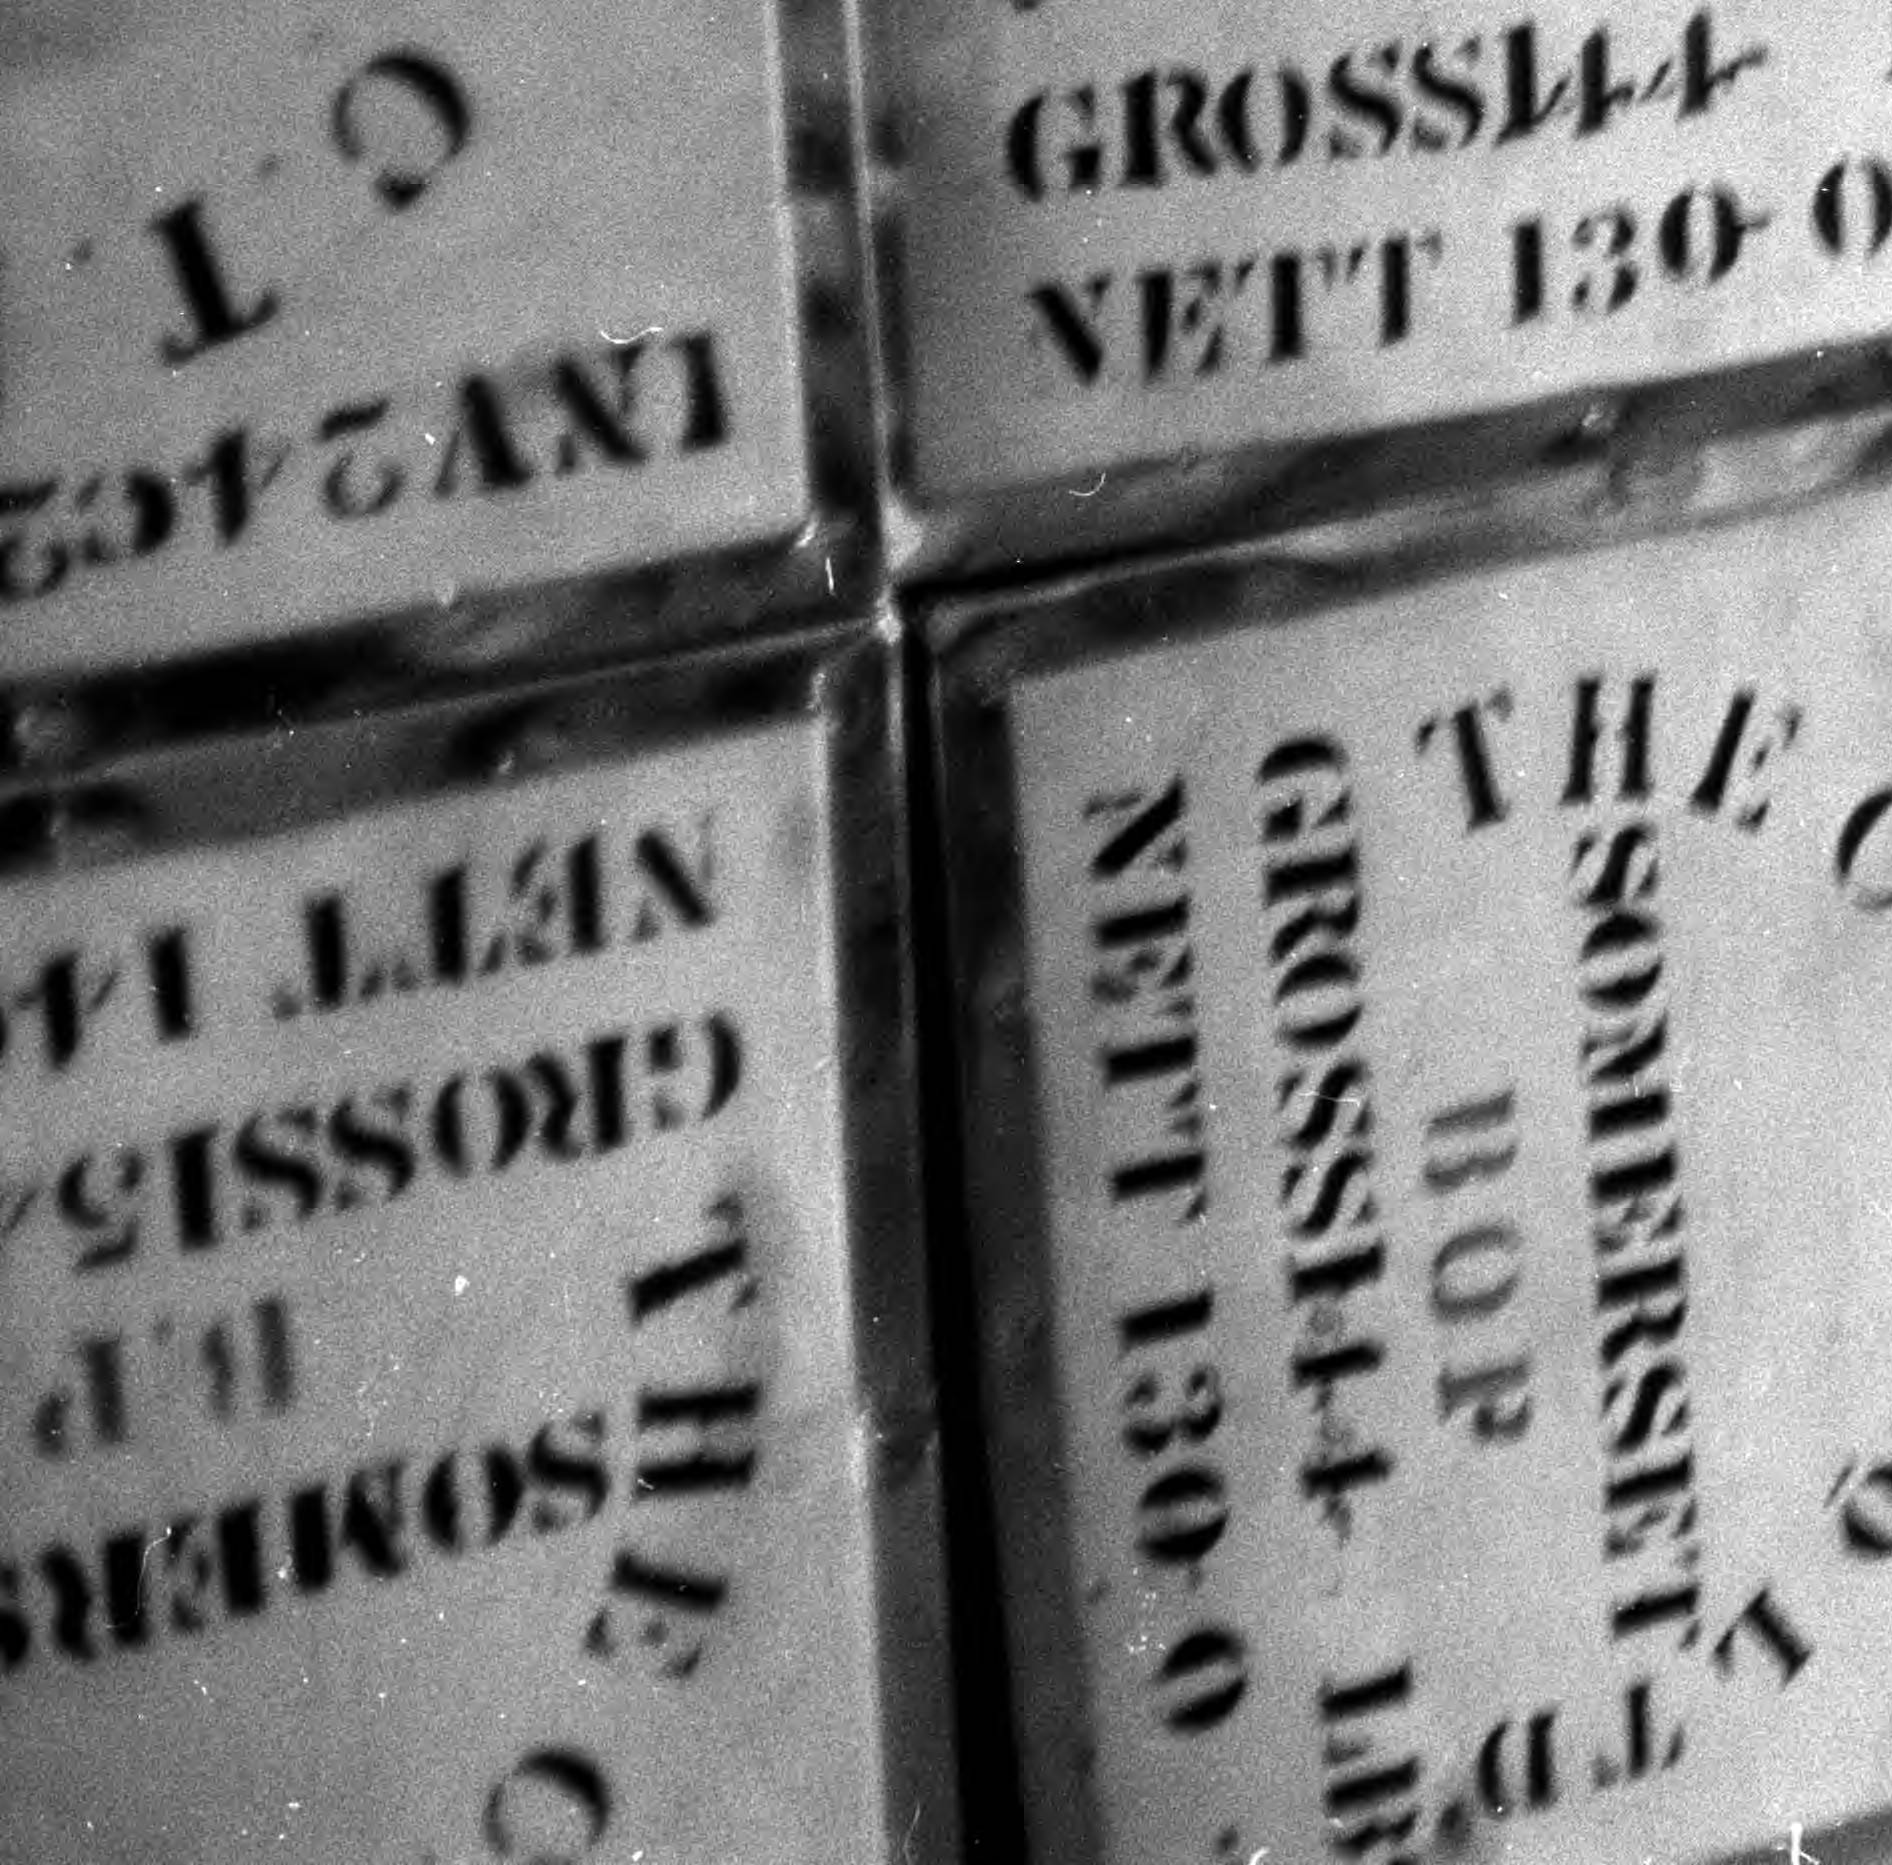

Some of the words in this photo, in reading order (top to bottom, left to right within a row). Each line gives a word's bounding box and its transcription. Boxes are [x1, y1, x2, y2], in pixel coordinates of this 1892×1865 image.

[1020, 228, 1433, 390] NETT
[1414, 673, 1800, 836] THE
[265, 796, 718, 1021] NETT
[1085, 778, 1207, 1224] NETT
[1422, 1090, 1533, 1446] BOP
[1575, 822, 1700, 1646] SOMERSET
